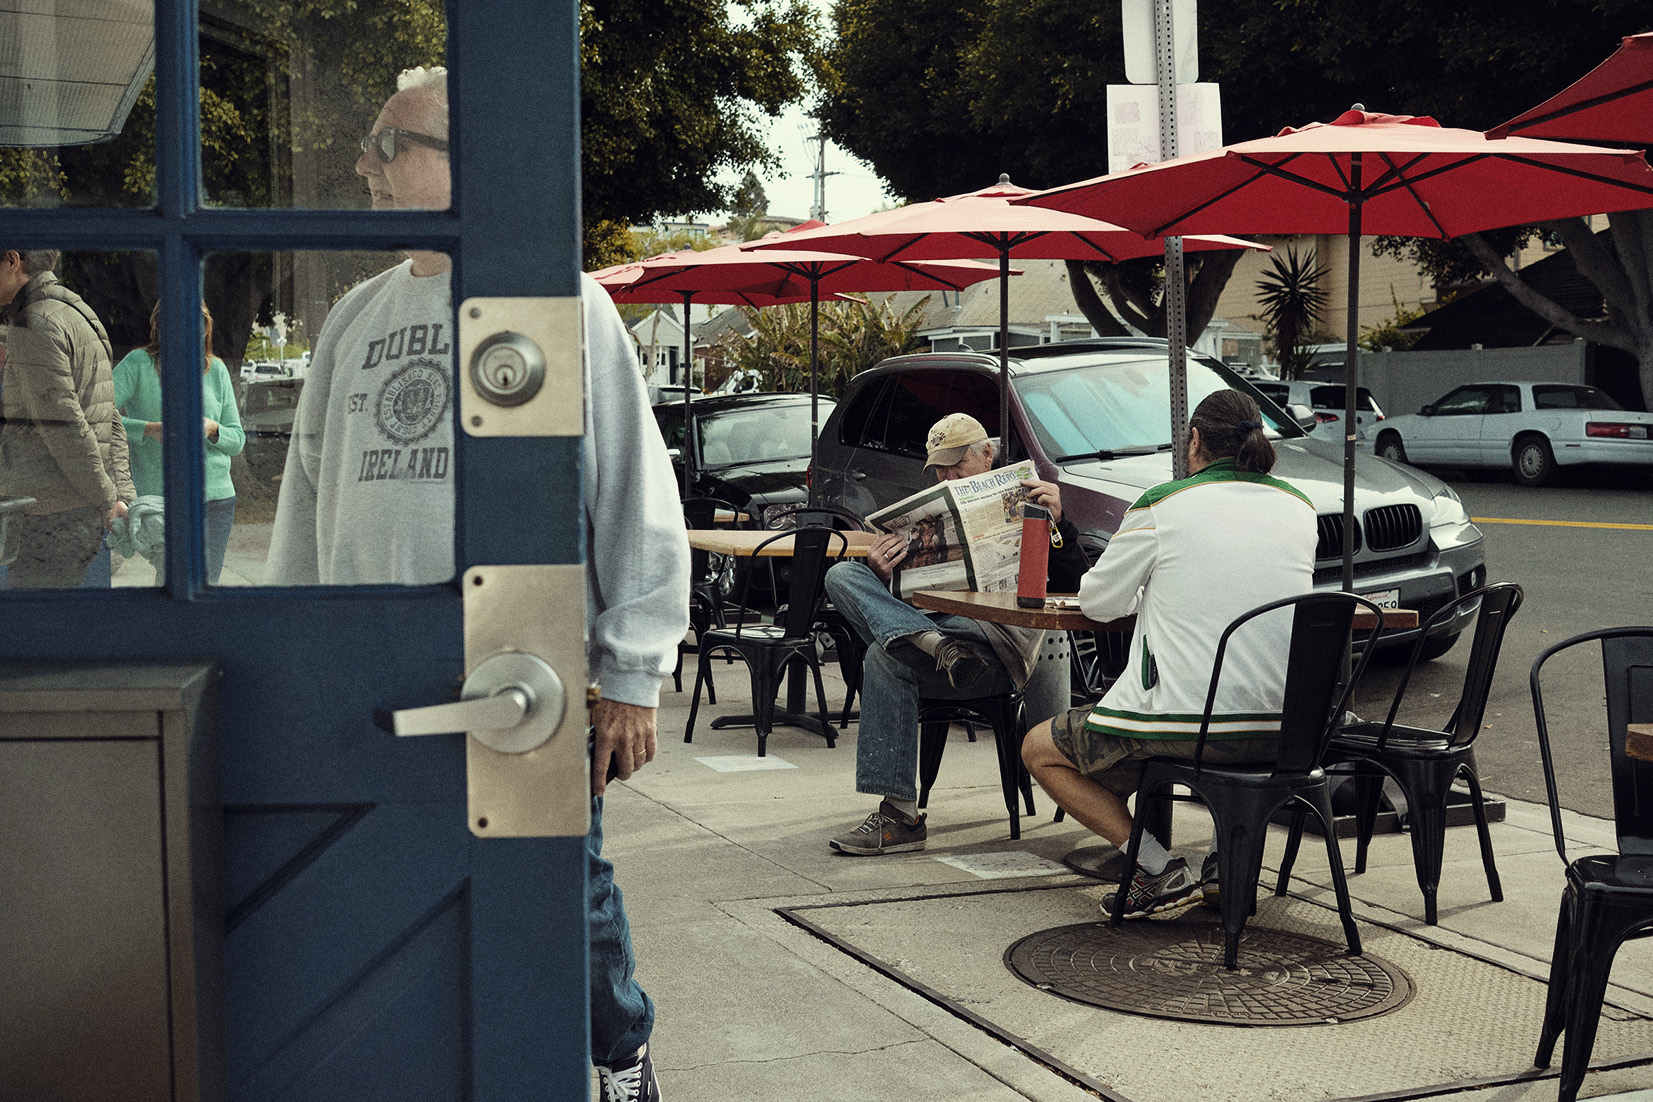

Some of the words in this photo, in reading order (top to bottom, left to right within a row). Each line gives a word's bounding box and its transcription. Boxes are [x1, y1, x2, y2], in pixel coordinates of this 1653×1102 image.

[358, 447, 449, 482] IRELAND
[954, 485, 970, 496] THE
[969, 478, 996, 494] BEACH
